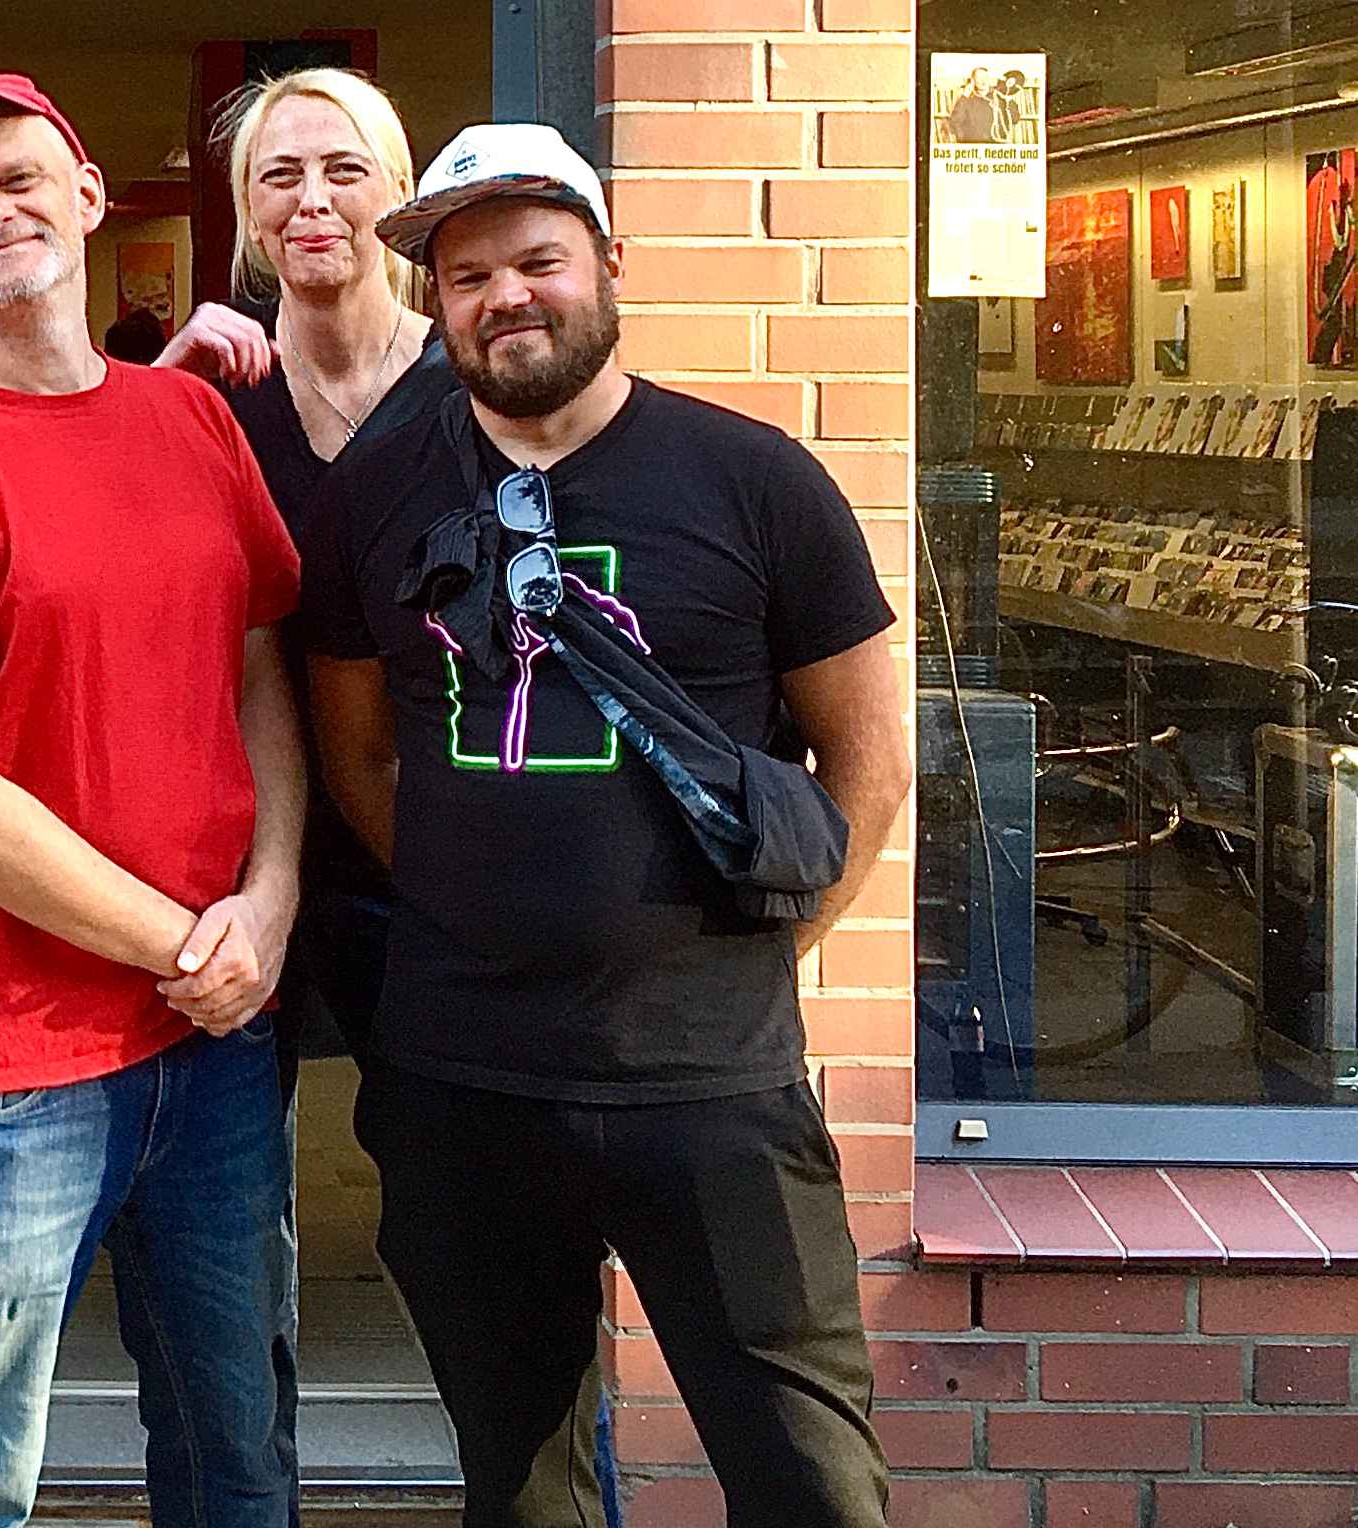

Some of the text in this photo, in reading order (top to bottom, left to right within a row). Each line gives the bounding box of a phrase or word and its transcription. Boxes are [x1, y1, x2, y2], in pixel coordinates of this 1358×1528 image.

[933, 148, 951, 159] Das
[1020, 148, 1039, 159] und
[977, 163, 989, 173] so
[992, 161, 1027, 174] schön!
